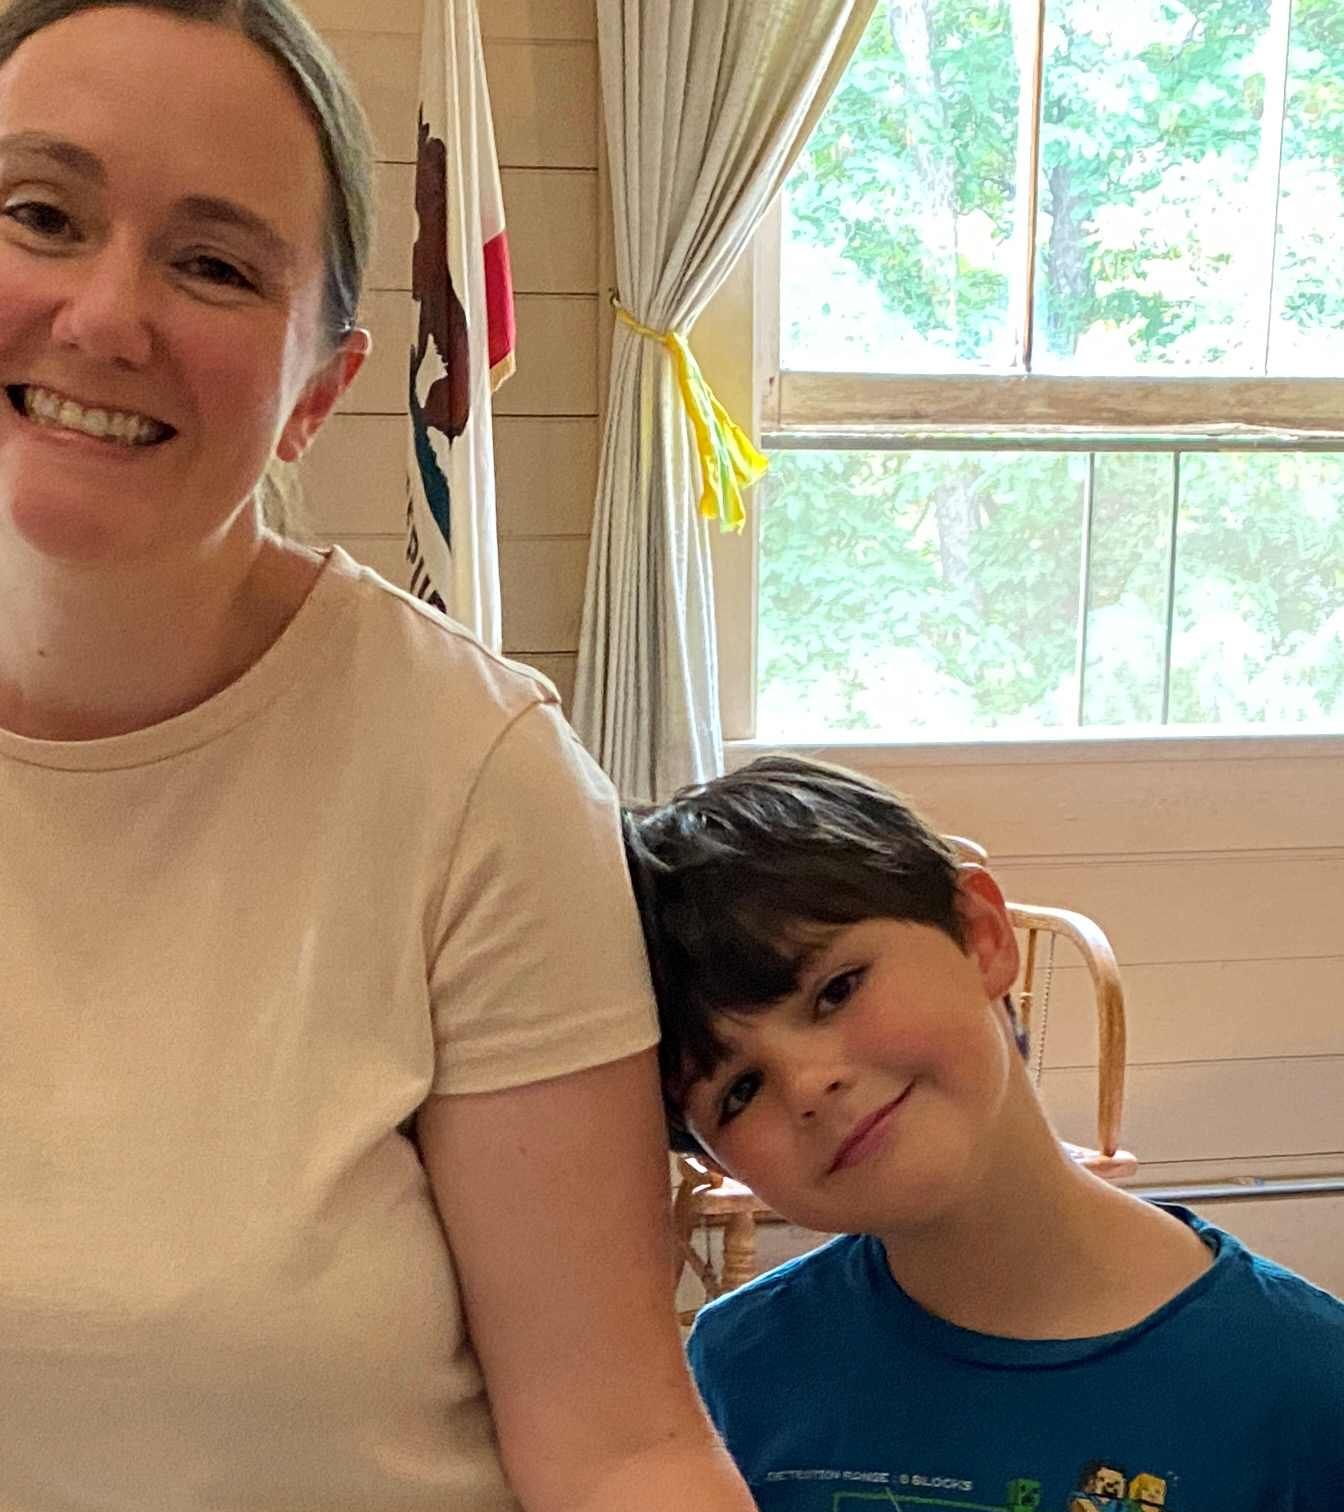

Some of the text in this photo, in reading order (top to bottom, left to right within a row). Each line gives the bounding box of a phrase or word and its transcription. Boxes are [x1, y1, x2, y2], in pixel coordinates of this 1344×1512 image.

[767, 1469, 840, 1482] DETECTION
[842, 1471, 890, 1484] RANGE
[911, 1475, 974, 1491] BLOCKS
